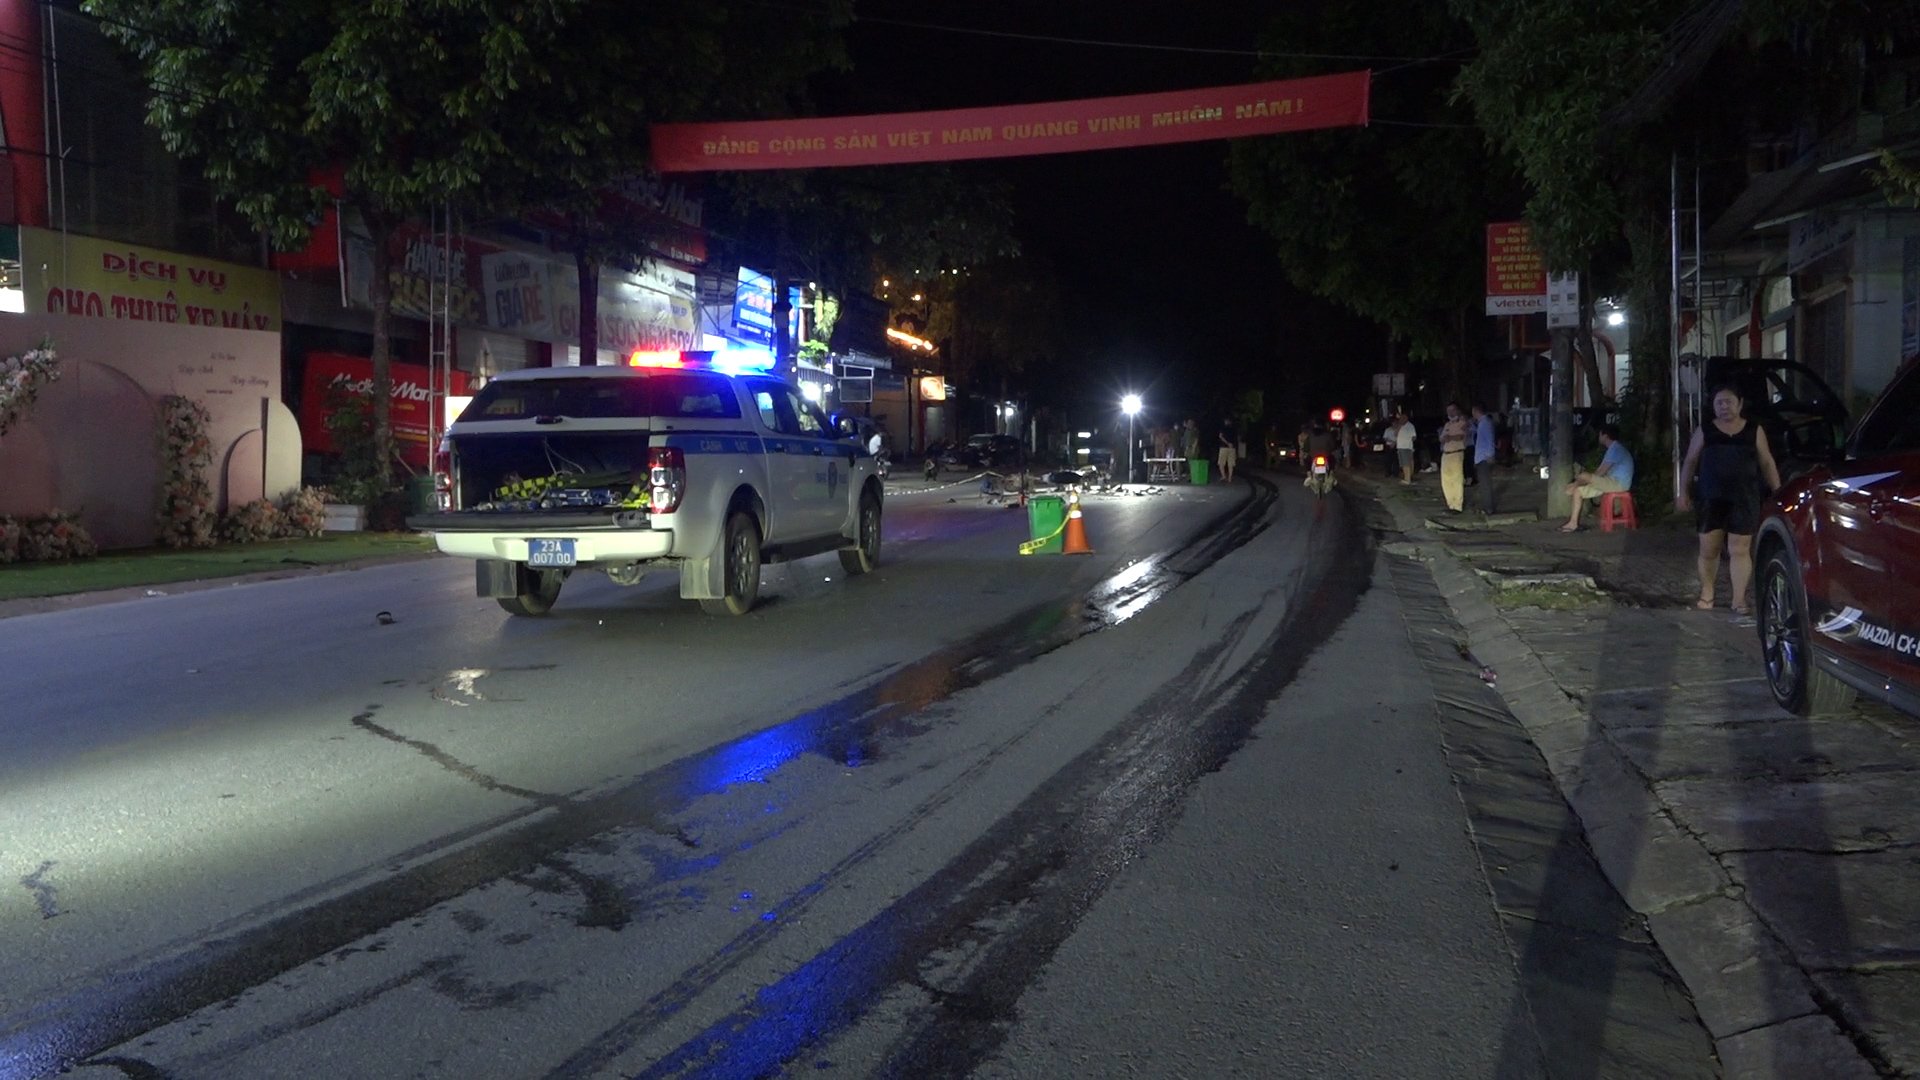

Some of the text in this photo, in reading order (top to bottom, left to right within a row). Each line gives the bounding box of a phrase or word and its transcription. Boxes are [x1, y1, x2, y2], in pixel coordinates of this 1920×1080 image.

[703, 136, 760, 155] ĐẢNG
[768, 134, 827, 155] CỘNG
[833, 129, 879, 150] SẢN
[887, 128, 933, 148] VIỆT
[941, 126, 993, 144] NAM
[1001, 121, 1079, 141] QUANG
[1087, 115, 1142, 136] VINH
[1152, 105, 1222, 128] MUÔN
[103, 253, 226, 292] DỊCH VỤ
[46, 287, 103, 317] CHO
[111, 290, 177, 324] THUÊ
[541, 541, 562, 552] 23A
[1857, 622, 1895, 649] MAZDA
